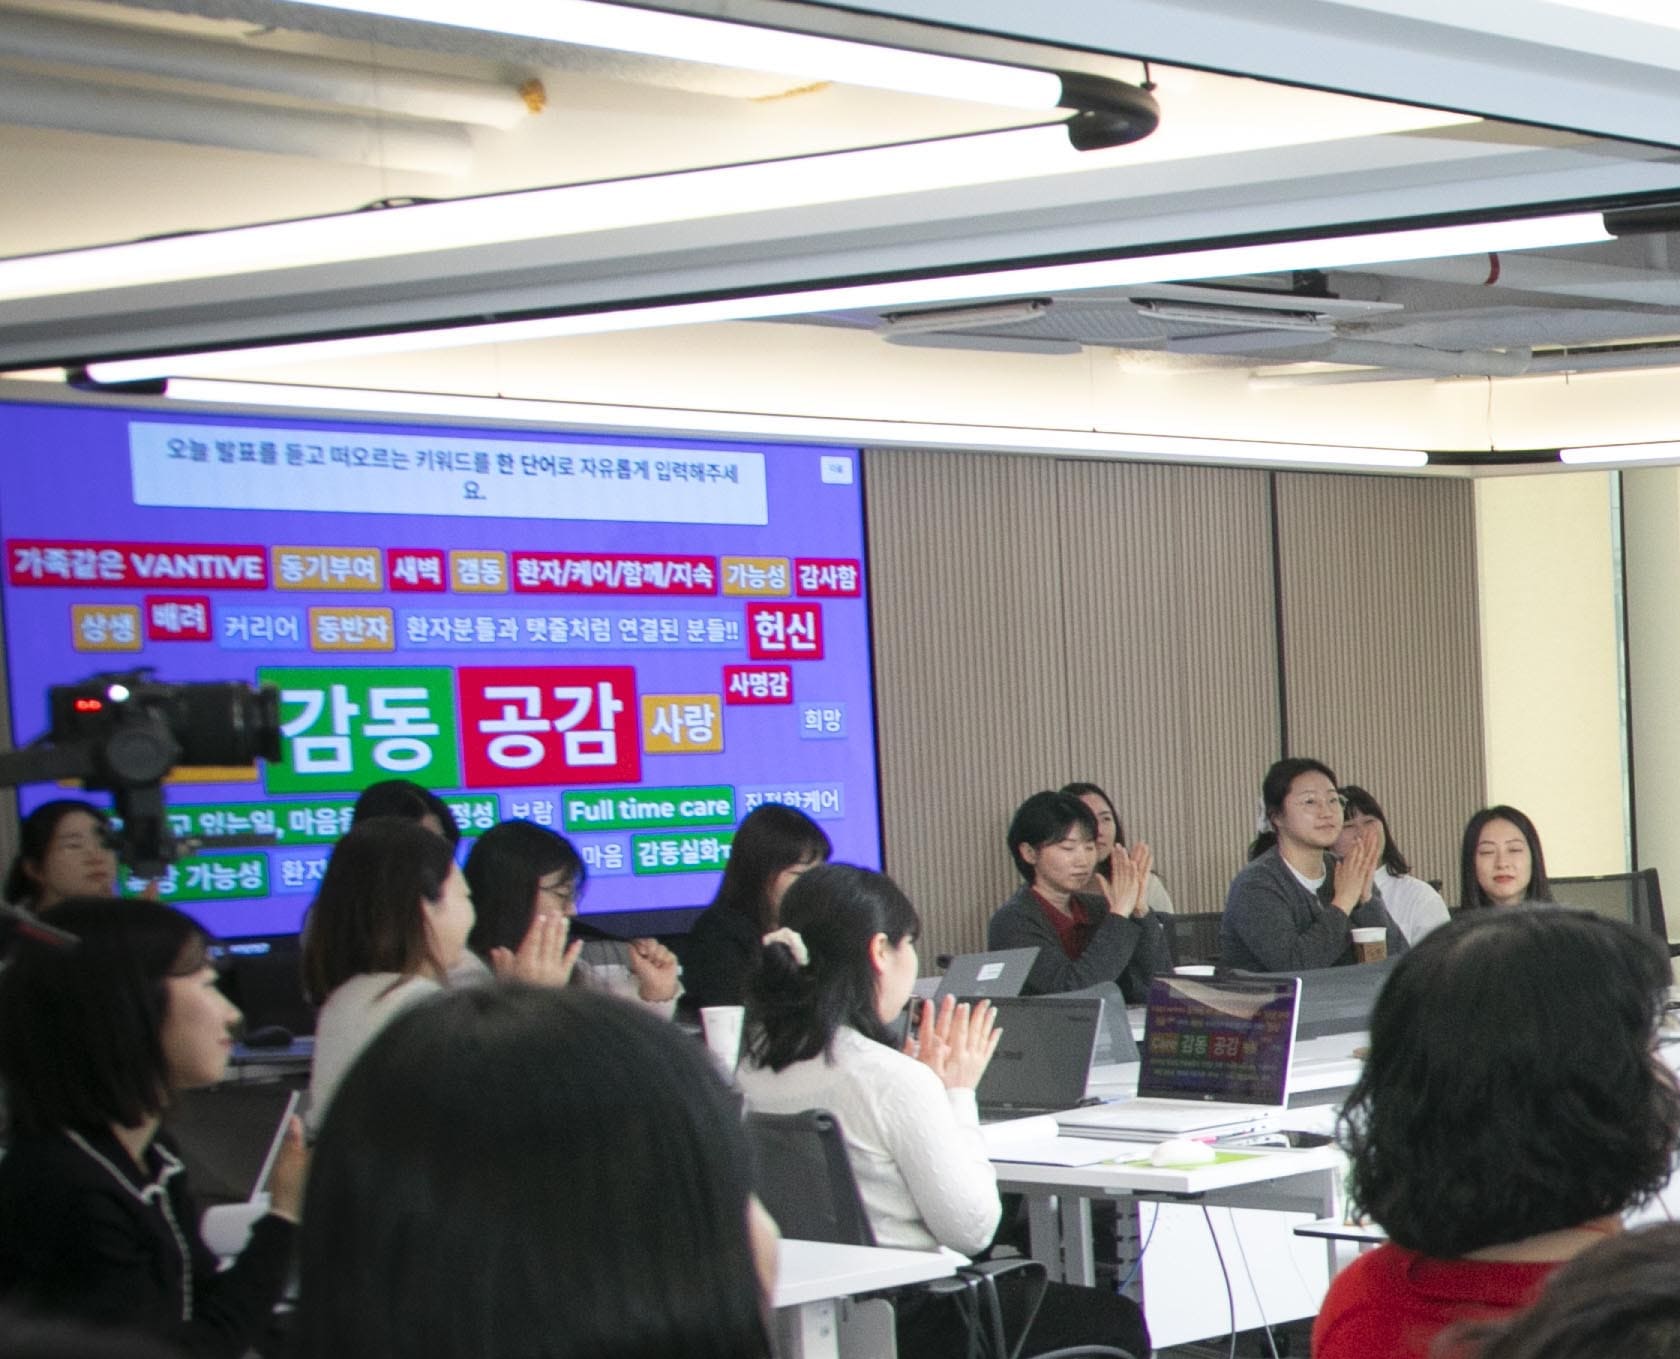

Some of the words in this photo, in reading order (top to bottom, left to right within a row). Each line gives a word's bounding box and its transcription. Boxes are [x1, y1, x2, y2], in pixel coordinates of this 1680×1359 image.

[167, 437, 207, 462] 오늘
[216, 440, 276, 464] 발표를
[286, 443, 324, 465] 듣고
[331, 446, 410, 470] 떠오르는
[417, 449, 489, 474] 키워드를
[498, 453, 514, 476] 한
[521, 456, 573, 477] 단어로
[580, 457, 650, 481] 자유롭게
[656, 461, 739, 484] 입력해주세
[15, 549, 125, 580] 가족같은
[131, 554, 263, 581] VANTIVE
[280, 555, 376, 583] 동기부여
[394, 557, 441, 585] 새벽
[517, 559, 714, 590] 환자/케어/함께/지속
[727, 564, 786, 590] 가능성
[799, 565, 857, 592] 감사함
[81, 616, 135, 643] 상생
[152, 603, 206, 633] 배려
[225, 616, 298, 642] 커리어
[318, 617, 388, 643] 동반자
[407, 617, 518, 643] 환자분들과
[618, 618, 680, 643] 연결된
[686, 618, 739, 643] 분들!!
[755, 612, 817, 651] 헌신
[730, 672, 790, 699] 사명감
[281, 684, 440, 774] 감동
[478, 681, 623, 769] 공감
[651, 704, 714, 745] 사랑
[804, 708, 842, 734] 희망
[450, 803, 494, 829] 정성
[570, 801, 615, 821] Full
[619, 798, 673, 819] time
[684, 800, 730, 817] care
[584, 846, 623, 870] 마음
[187, 861, 262, 890] 가능성
[1181, 1034, 1208, 1056] 감동
[1213, 1035, 1240, 1057] 공감
